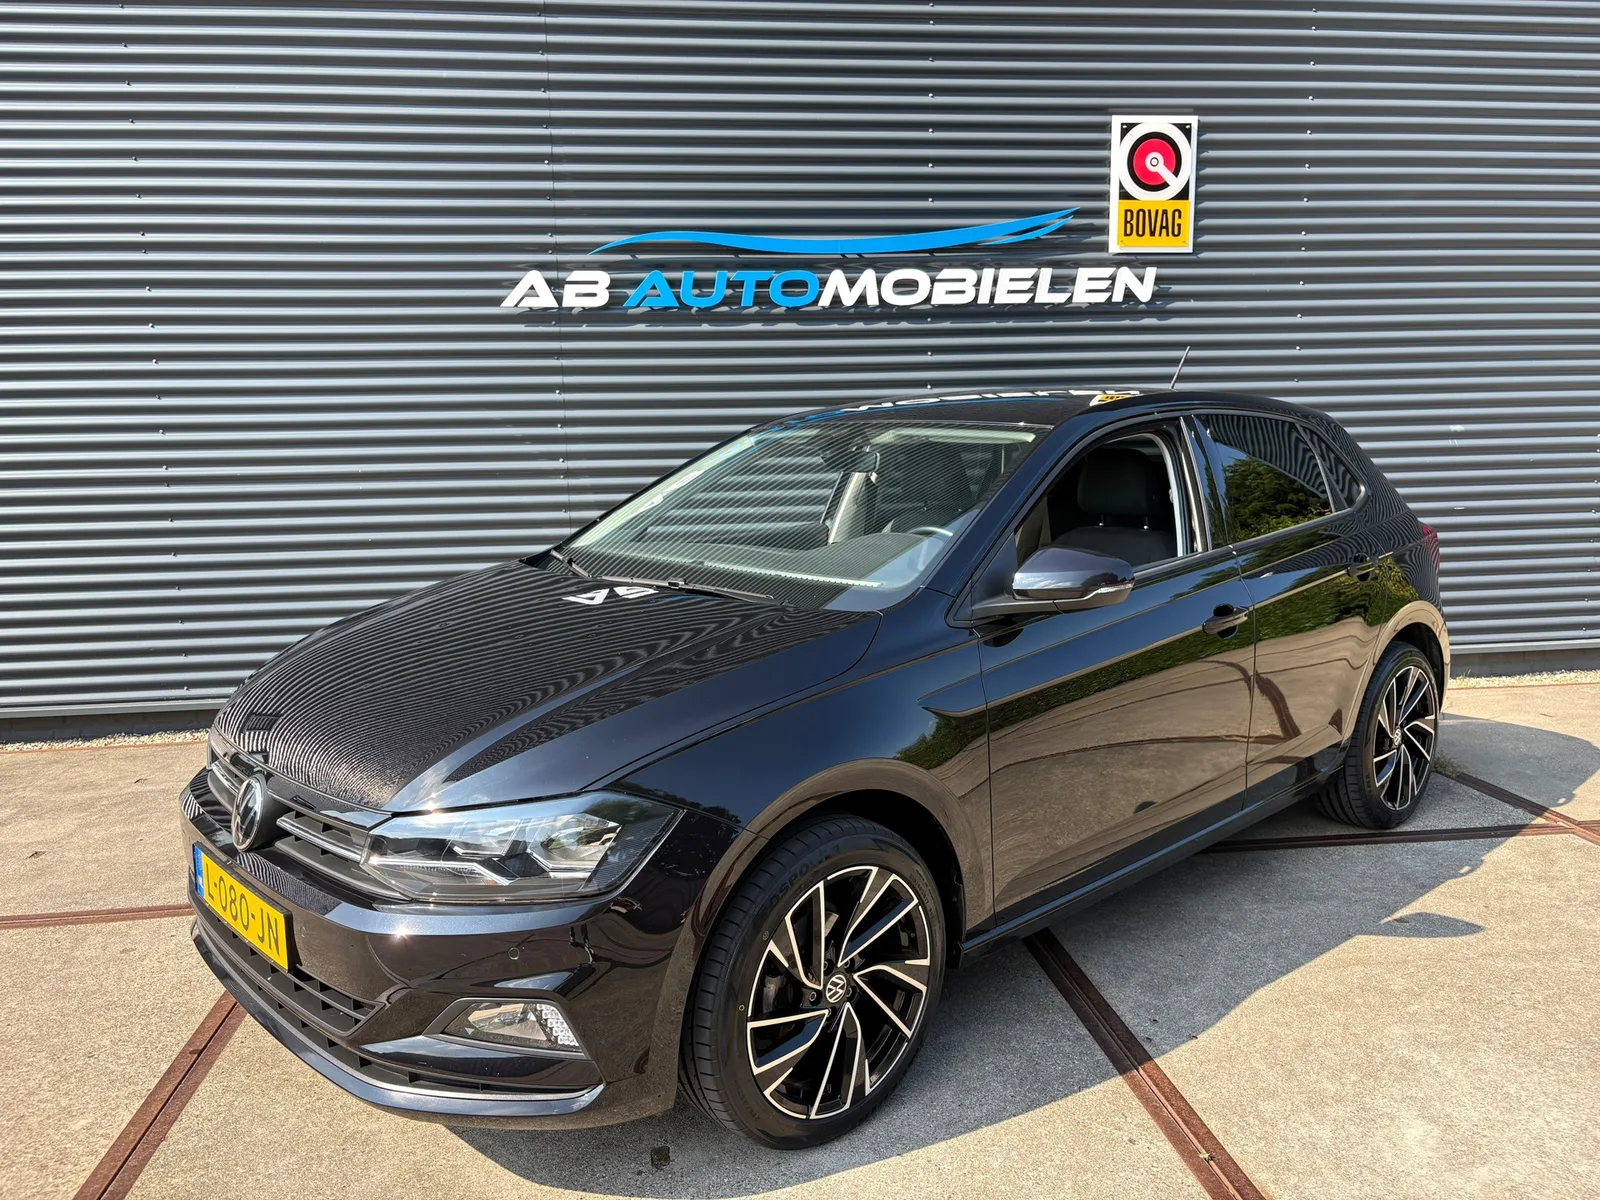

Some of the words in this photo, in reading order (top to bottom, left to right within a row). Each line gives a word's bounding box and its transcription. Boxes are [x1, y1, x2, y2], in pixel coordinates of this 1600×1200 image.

[1123, 208, 1182, 238] BOVAG
[500, 269, 611, 307] AB
[623, 266, 1157, 308] AUTOMOBIELEN
[206, 863, 280, 955] L-080-JN
